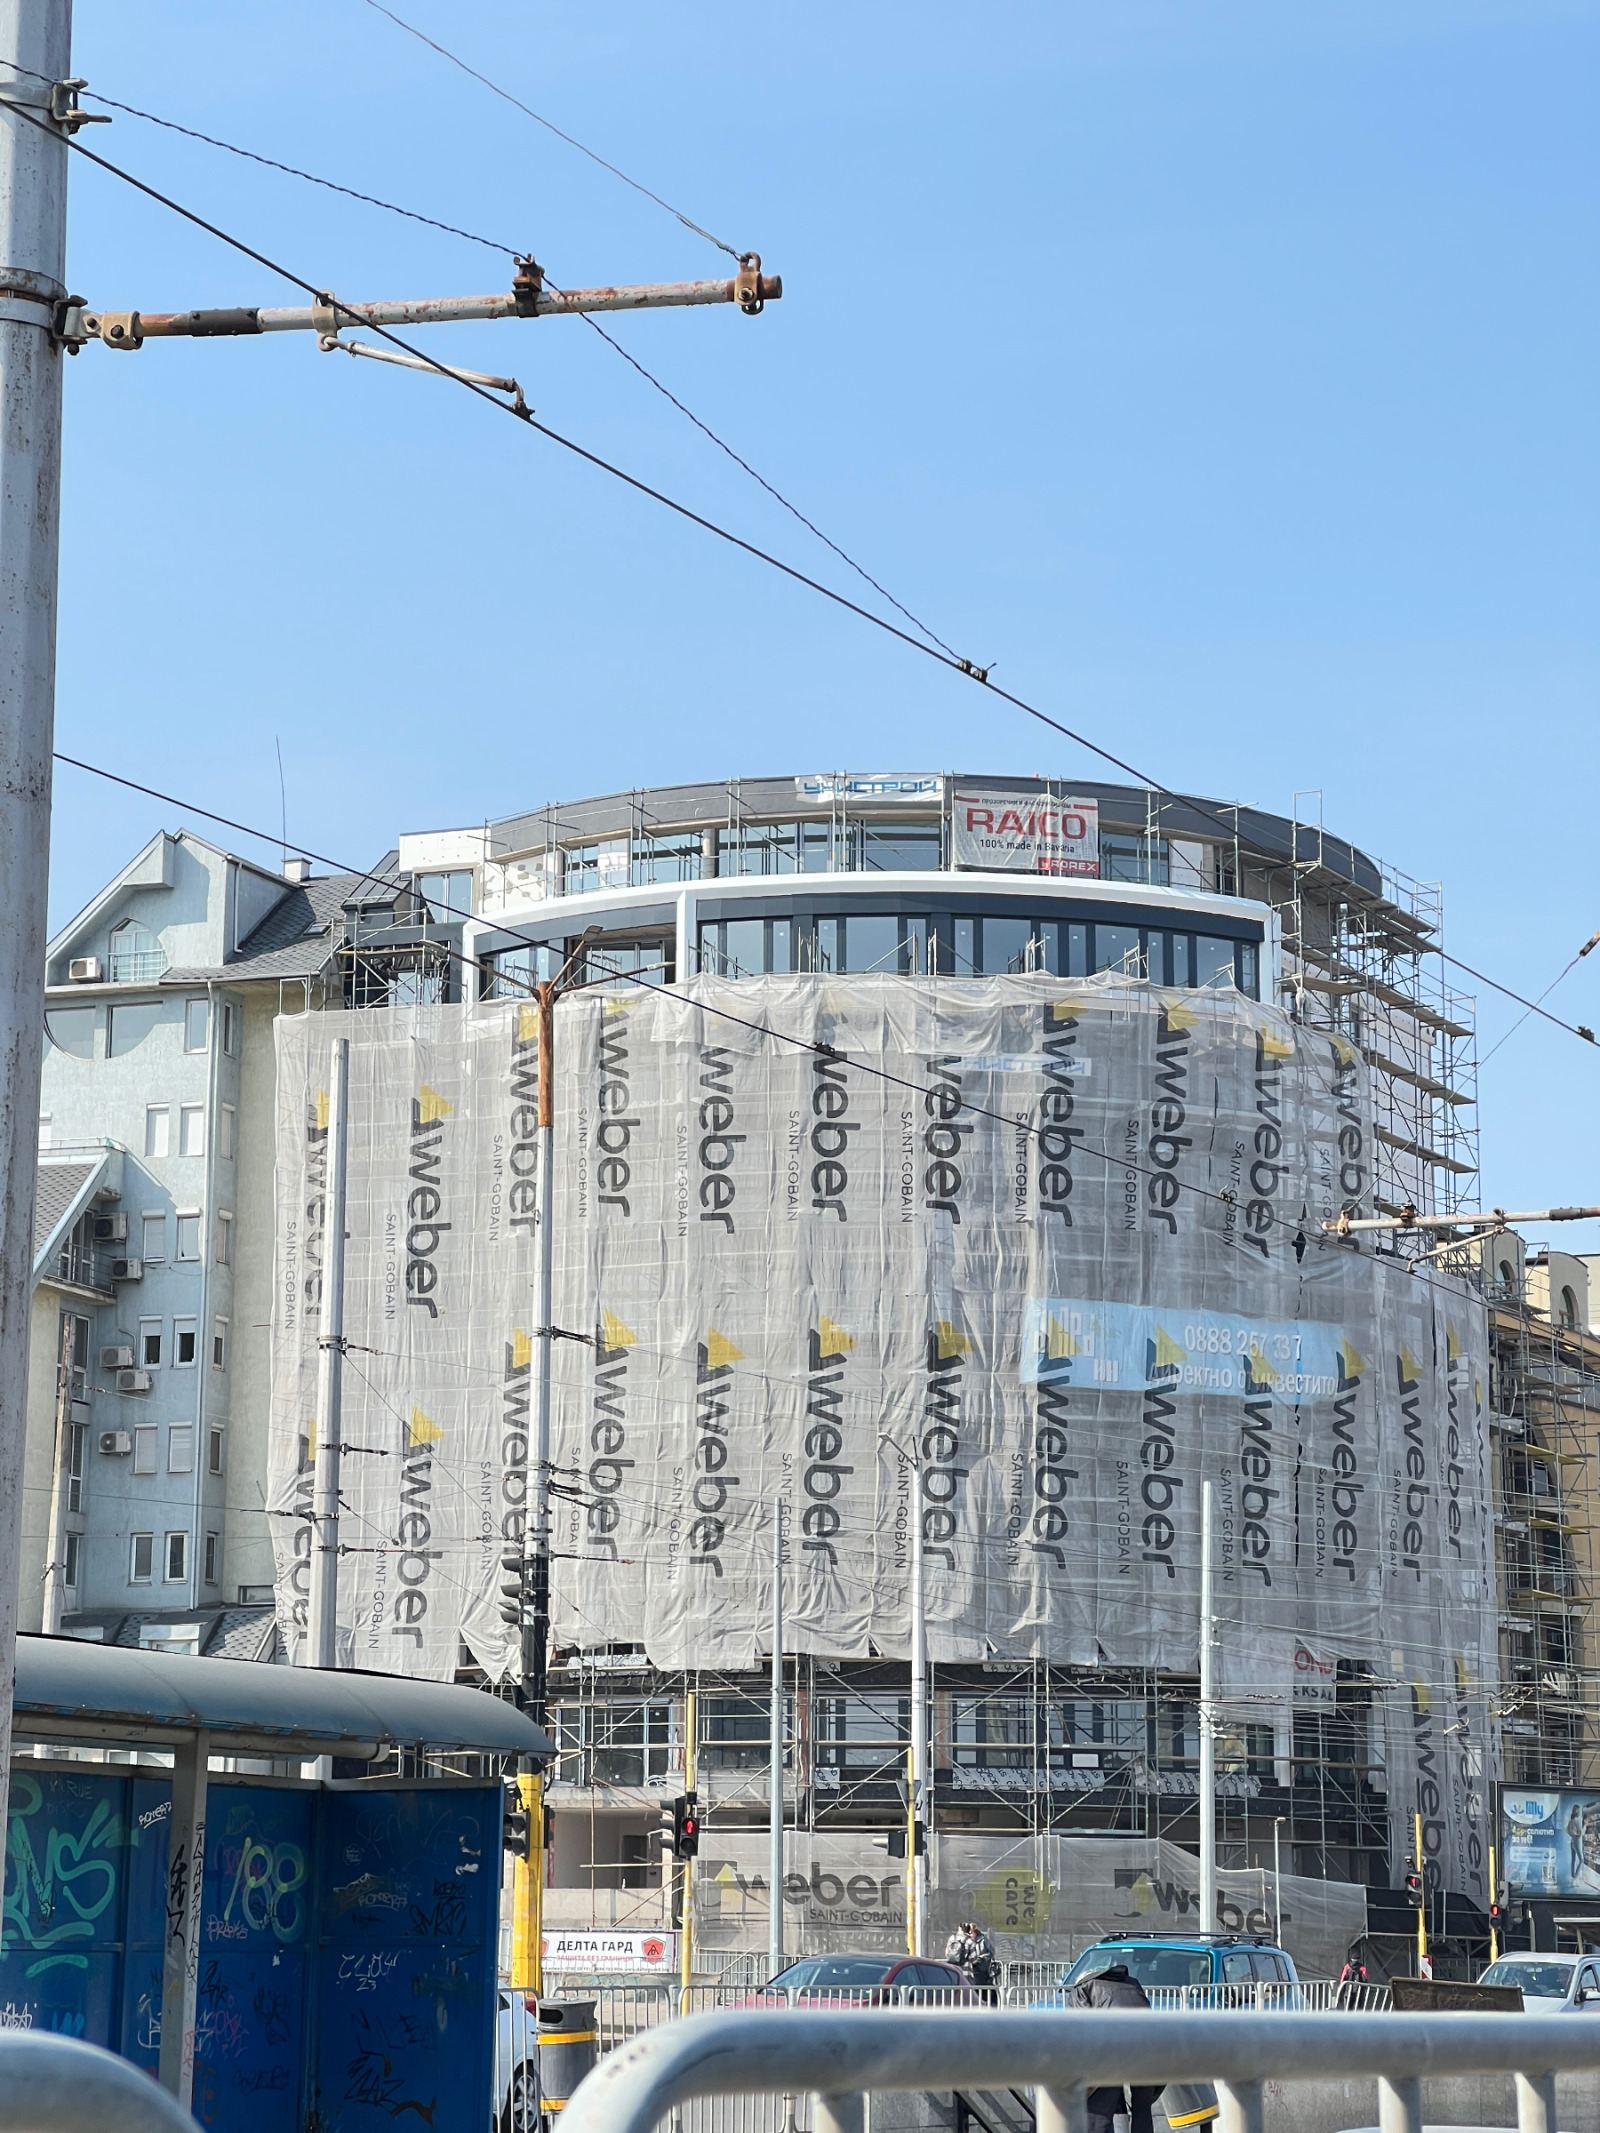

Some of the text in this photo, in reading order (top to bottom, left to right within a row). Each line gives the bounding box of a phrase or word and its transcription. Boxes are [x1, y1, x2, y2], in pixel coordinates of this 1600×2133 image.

[966, 807, 1087, 840] RAICO
[980, 839, 1004, 849] 100%
[1006, 841, 1032, 851] made
[1046, 843, 1075, 853] Bavaria
[577, 1106, 588, 1219] SAINT-GOBAIN
[597, 1027, 641, 1218] weber
[699, 1045, 748, 1234] weber
[786, 1110, 801, 1222] SAINT-GOBAIN
[901, 1111, 914, 1224] SAINT-GOBAIN
[1015, 1112, 1028, 1225] SAINT-GOBAIN
[1039, 1035, 1085, 1227] weber
[1124, 1119, 1140, 1231] SAINT-GOBAIN
[1149, 1046, 1193, 1235] weber
[1243, 1077, 1290, 1259] weber
[405, 1134, 452, 1319] weber
[489, 1134, 503, 1242] SAINT-GOBAIN
[676, 1125, 688, 1238] SAINT-GOBAIN
[1224, 1140, 1245, 1248] SAINT-GOBAIN
[284, 1221, 297, 1330] SAINT-GOBAIN
[384, 1213, 397, 1320] SAINT-GOBAIN
[1184, 1325, 1232, 1355] 0888
[480, 1461, 493, 1572] SAINT-GOBAIN
[587, 1365, 636, 1560] weber
[689, 1382, 740, 1578] weber
[780, 1452, 792, 1566] SAINT-GOBAIN
[802, 1372, 854, 1565] weber
[894, 1454, 908, 1569] SAINT-GOBAIN
[920, 1374, 969, 1571] weber
[1006, 1453, 1023, 1567] SAINT-GOBAIN
[1032, 1376, 1079, 1570] weber
[1116, 1460, 1130, 1575] SAINT-GOBAIN
[1140, 1383, 1184, 1578] weber
[1241, 1400, 1280, 1587] weber
[1332, 1394, 1364, 1582] weber
[1402, 1396, 1430, 1582] weber
[1447, 1378, 1464, 1562] weber
[392, 1460, 443, 1649] weber
[667, 1466, 683, 1580] SAINT-GOBAIN
[1220, 1468, 1234, 1582] SAINT-GOBAIN
[1315, 1468, 1327, 1578] SAINT-GOBAIN
[1390, 1468, 1402, 1578] SAINT-GOBAIN
[369, 1540, 388, 1649] SAINT-GOBAIN
[1526, 1801, 1543, 1819] lilly
[736, 1861, 901, 1907] weber
[809, 1908, 904, 1924] SAINT-GOBAIN
[1005, 1876, 1019, 1927] care
[1022, 1884, 1036, 1921] we
[557, 1940, 633, 1953] ДЕЛТА ГАРД
